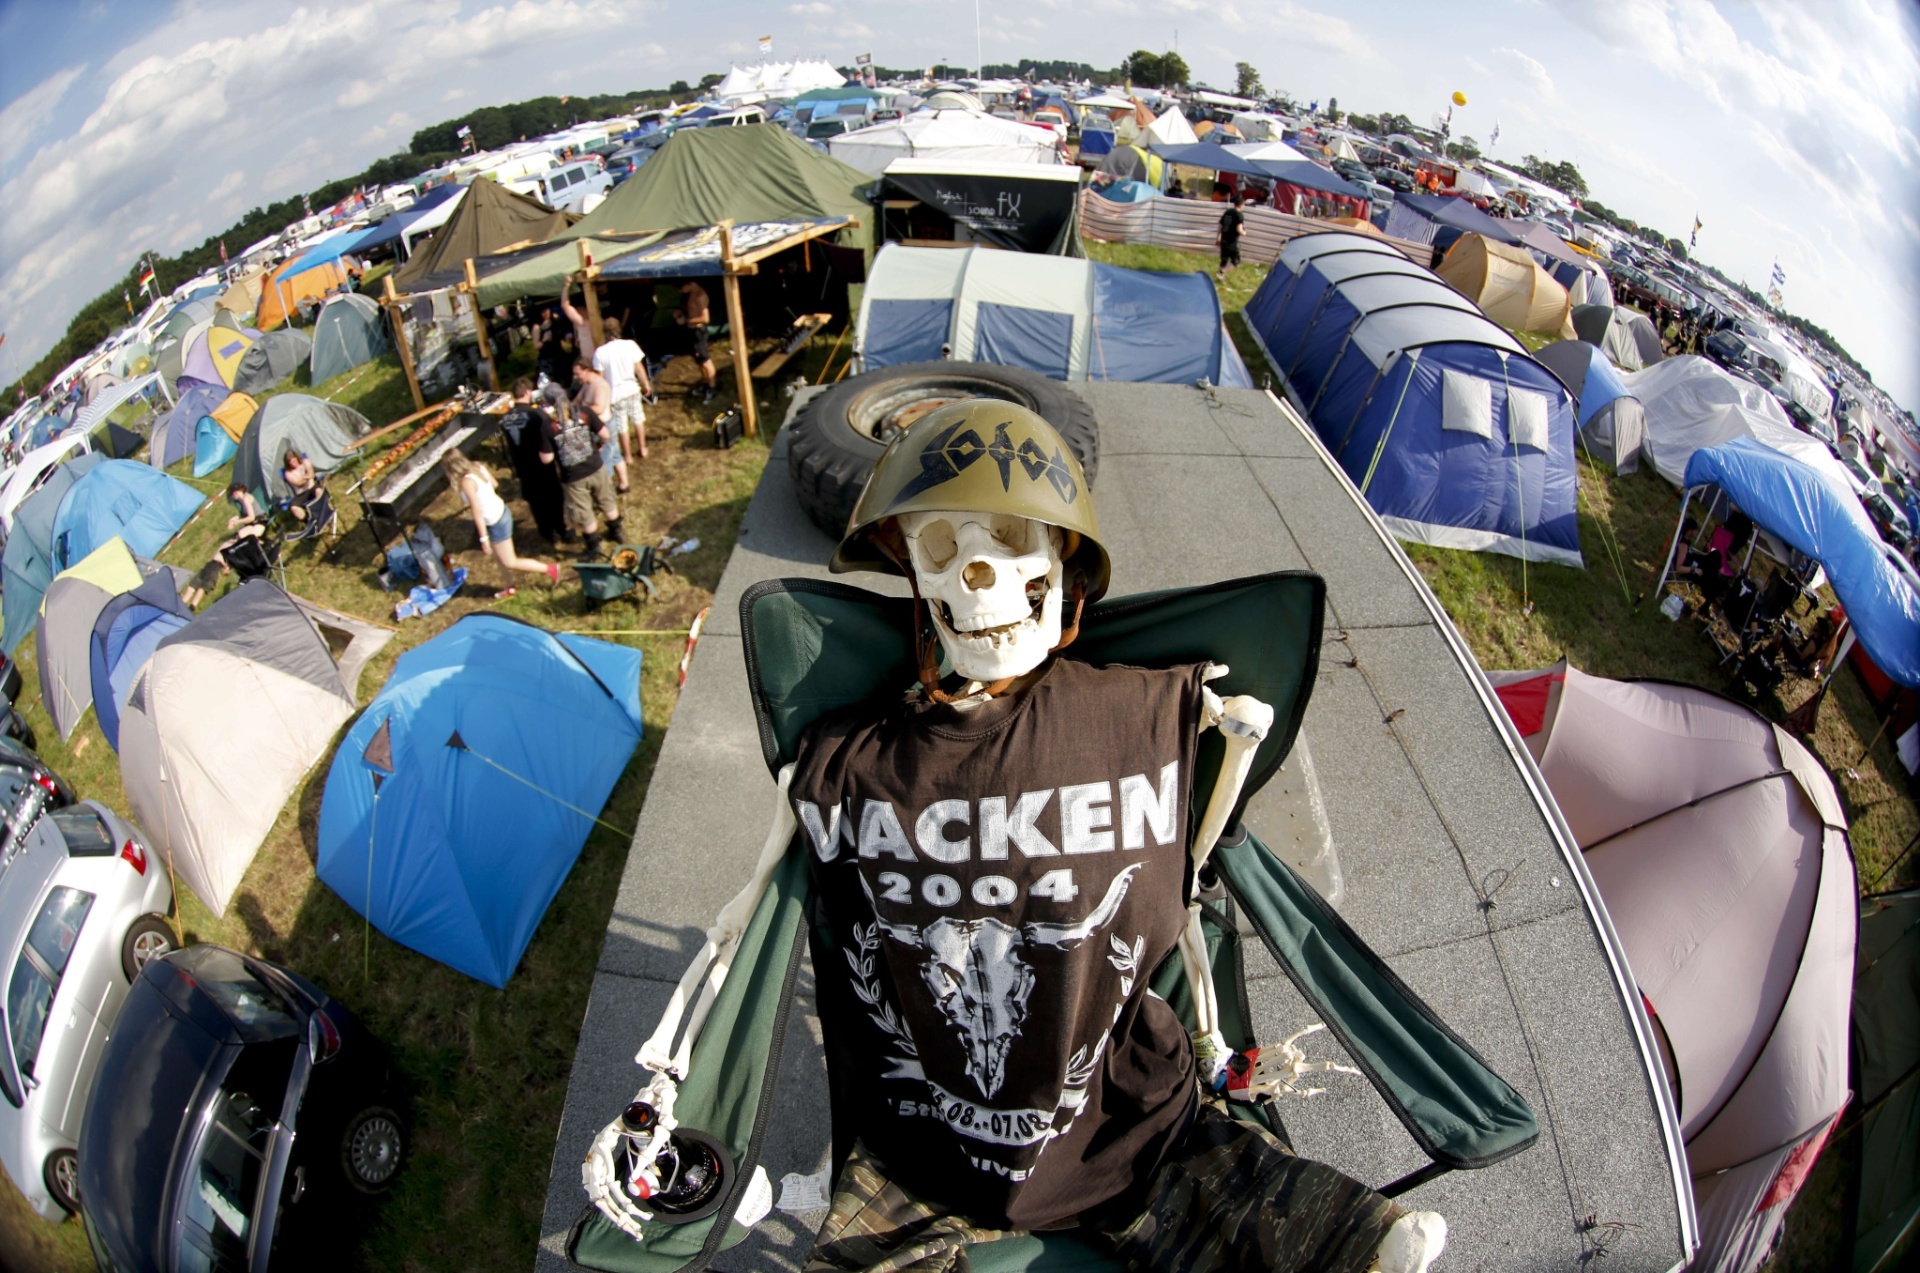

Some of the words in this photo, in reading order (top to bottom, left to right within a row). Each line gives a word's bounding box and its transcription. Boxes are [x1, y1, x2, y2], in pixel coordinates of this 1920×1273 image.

[795, 760, 1179, 863] WACKEN
[877, 868, 1079, 908] 2004
[887, 1097, 946, 1122] 5th
